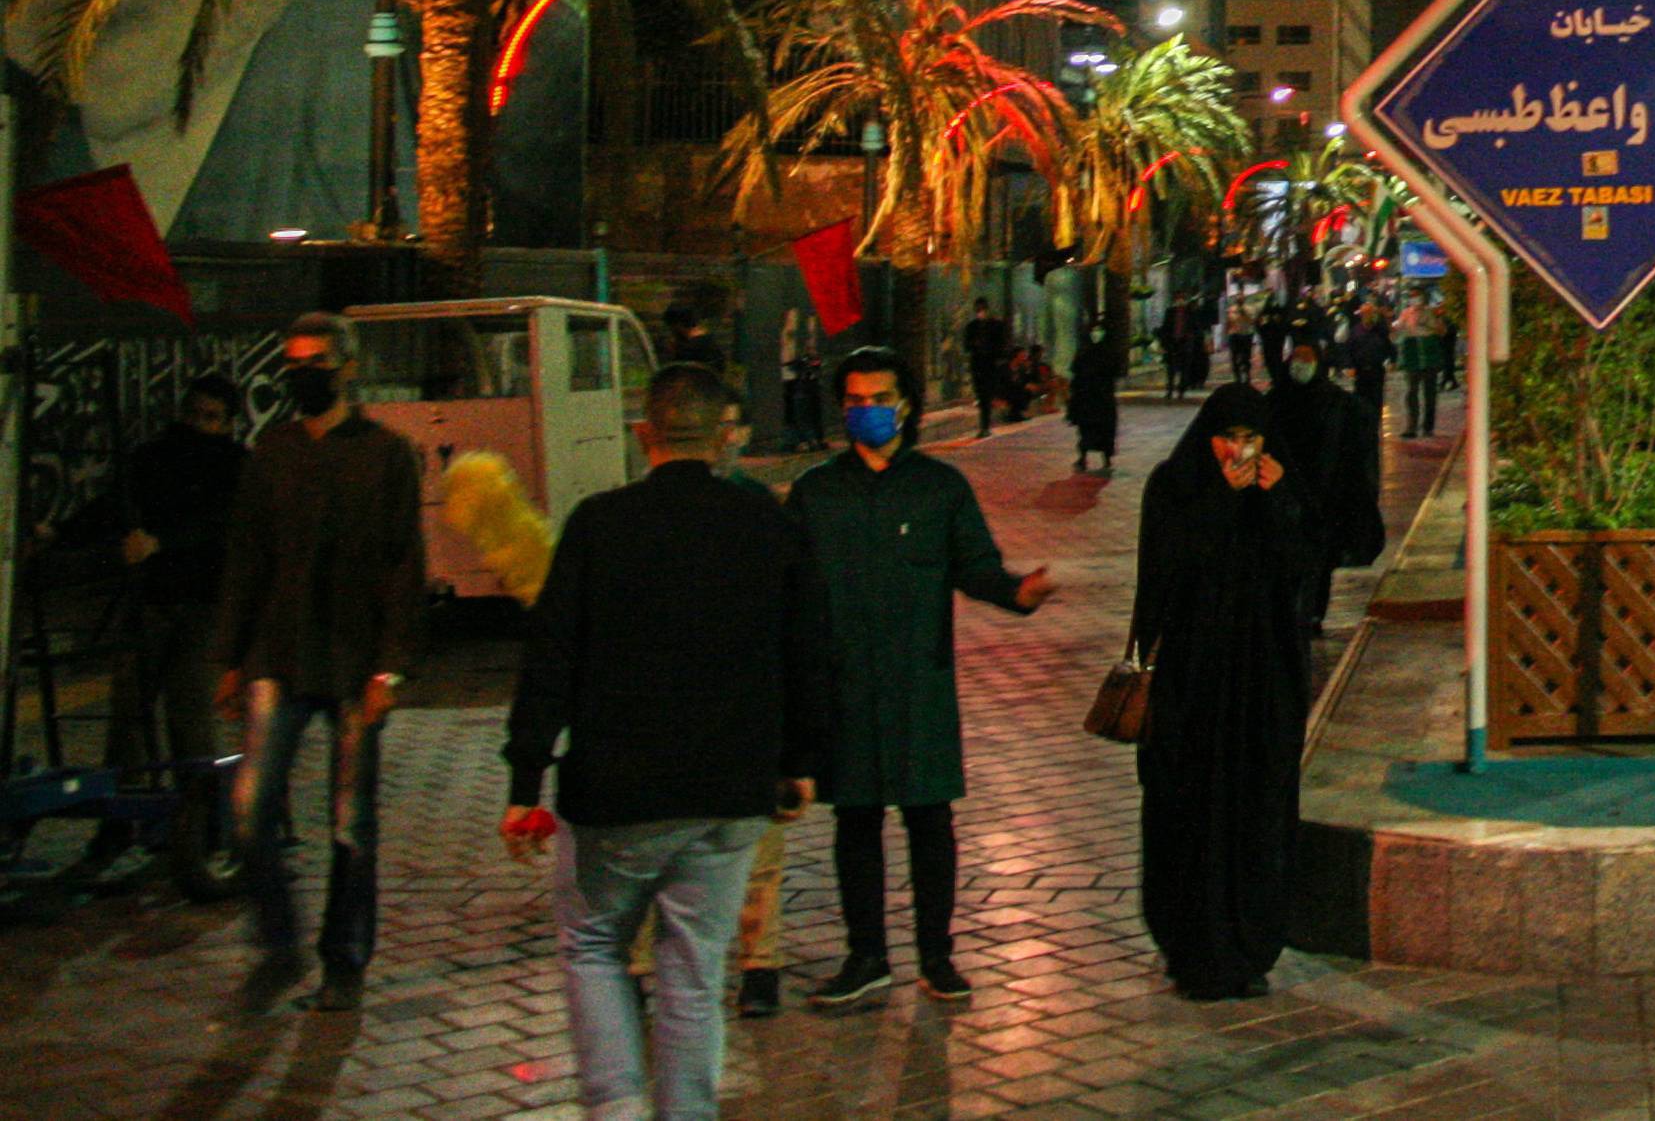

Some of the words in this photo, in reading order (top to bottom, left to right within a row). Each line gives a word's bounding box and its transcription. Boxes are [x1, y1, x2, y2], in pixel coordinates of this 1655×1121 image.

[1551, 5, 1651, 44] خیابان
[1423, 83, 1544, 149] طبسی
[1544, 80, 1649, 145] واعظ
[1502, 188, 1563, 207] VAEZ
[1568, 185, 1652, 206] TABASI
